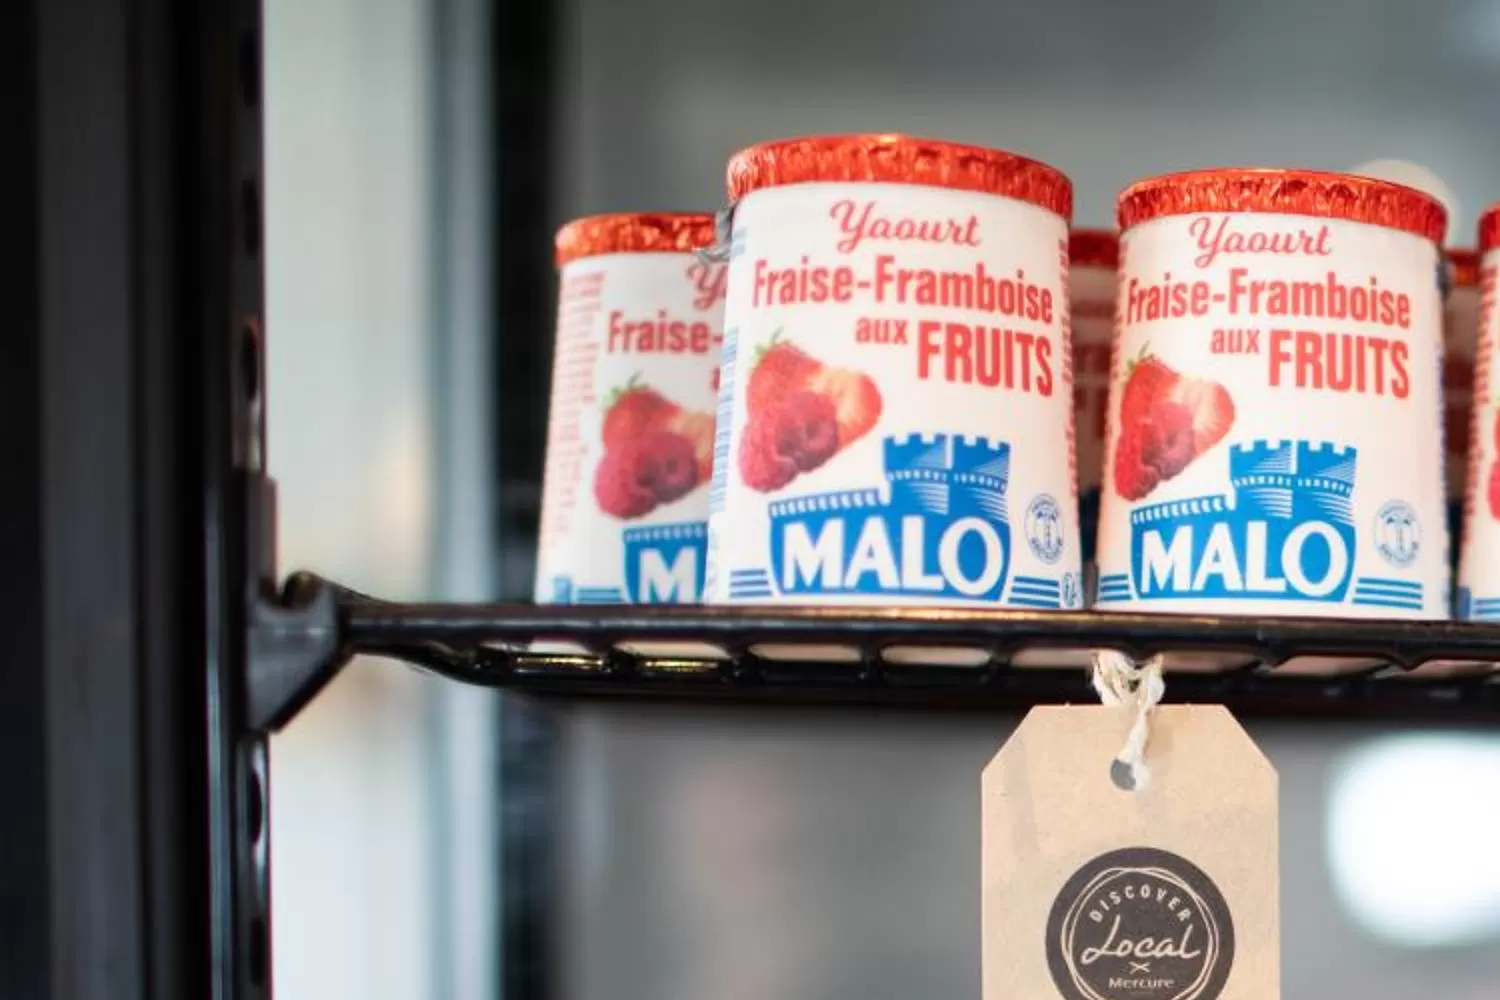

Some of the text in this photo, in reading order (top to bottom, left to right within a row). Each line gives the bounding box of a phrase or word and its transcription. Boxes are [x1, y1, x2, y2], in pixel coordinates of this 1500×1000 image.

[829, 200, 981, 254] Yaourt
[1188, 216, 1332, 268] Yaourt
[752, 256, 1053, 324] Fraise-Framboise
[1127, 268, 1410, 328] Fraise-Framboise
[855, 317, 1052, 397] aux FRUITS
[1211, 328, 1409, 399] aux FRUITS
[783, 516, 1003, 597] MALO
[1141, 521, 1348, 597] MALO
[1089, 883, 1192, 922] DISCOVER
[1081, 914, 1200, 965] Local
[1108, 977, 1175, 989] Mercure
